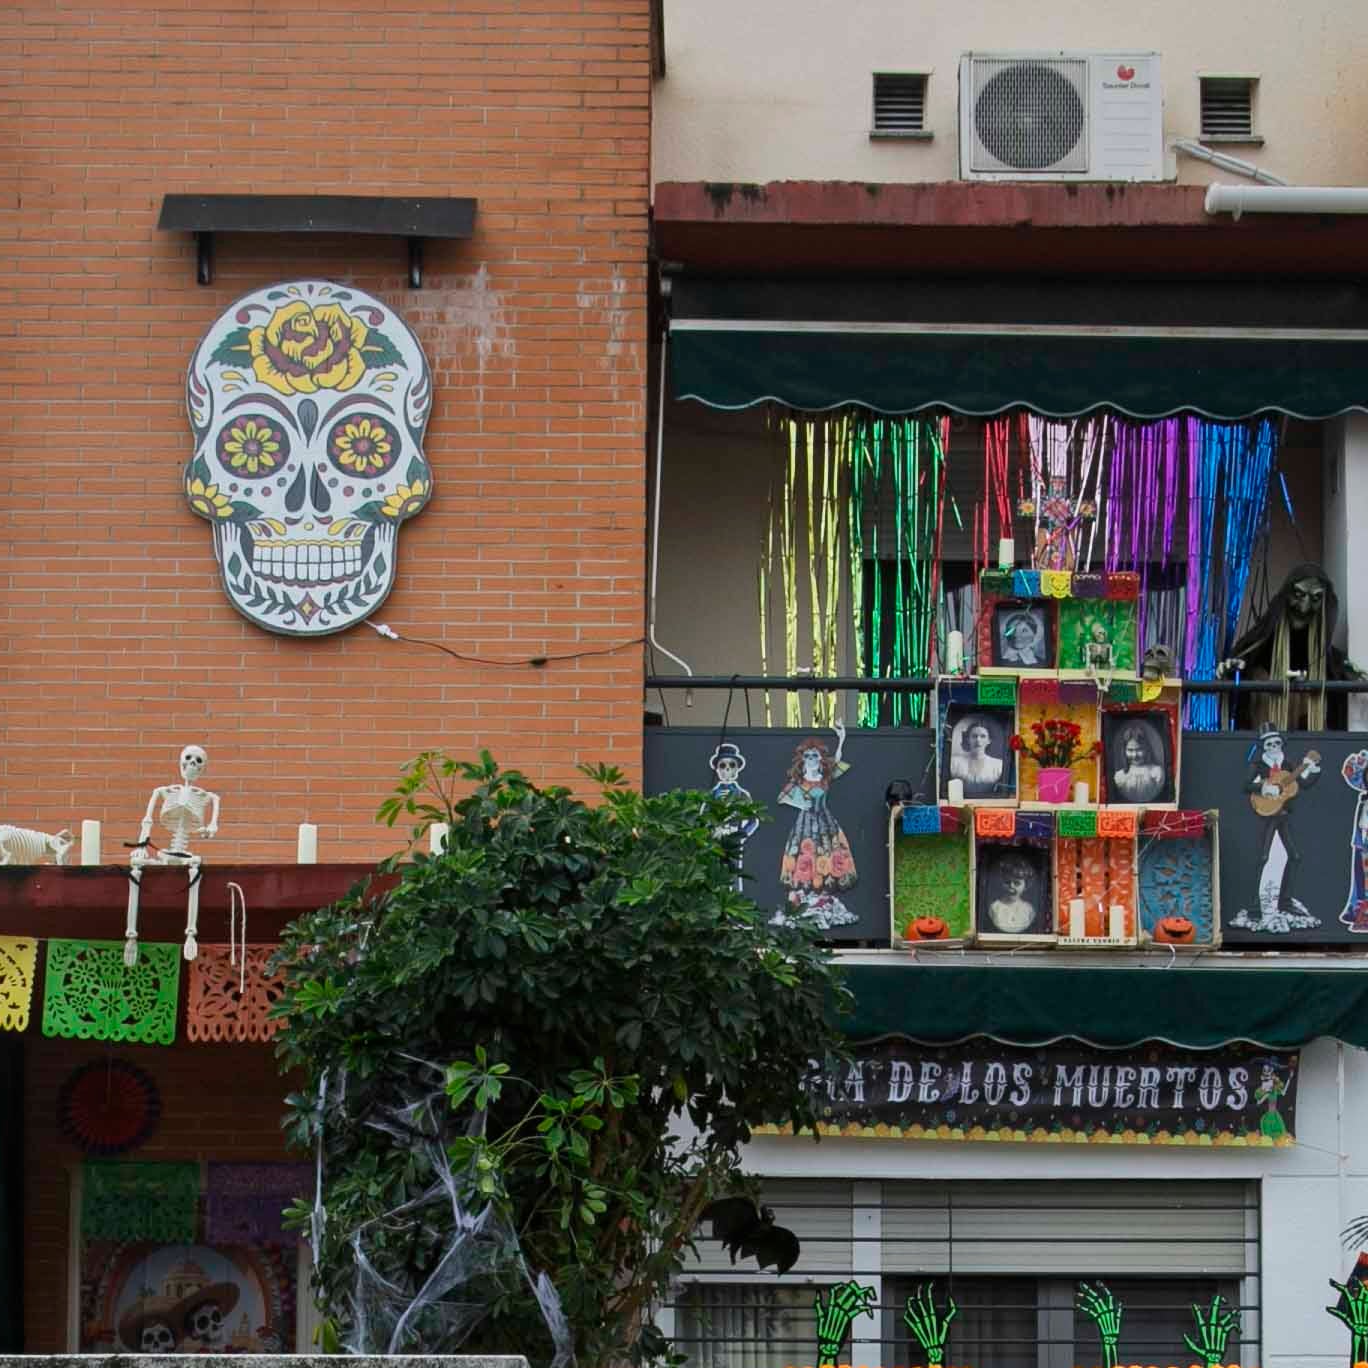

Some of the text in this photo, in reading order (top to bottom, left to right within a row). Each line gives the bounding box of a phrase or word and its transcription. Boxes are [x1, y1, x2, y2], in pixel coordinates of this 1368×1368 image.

[888, 1060, 942, 1104] DE
[958, 1061, 1033, 1106] LOS
[1052, 1064, 1250, 1111] MUERTOS
